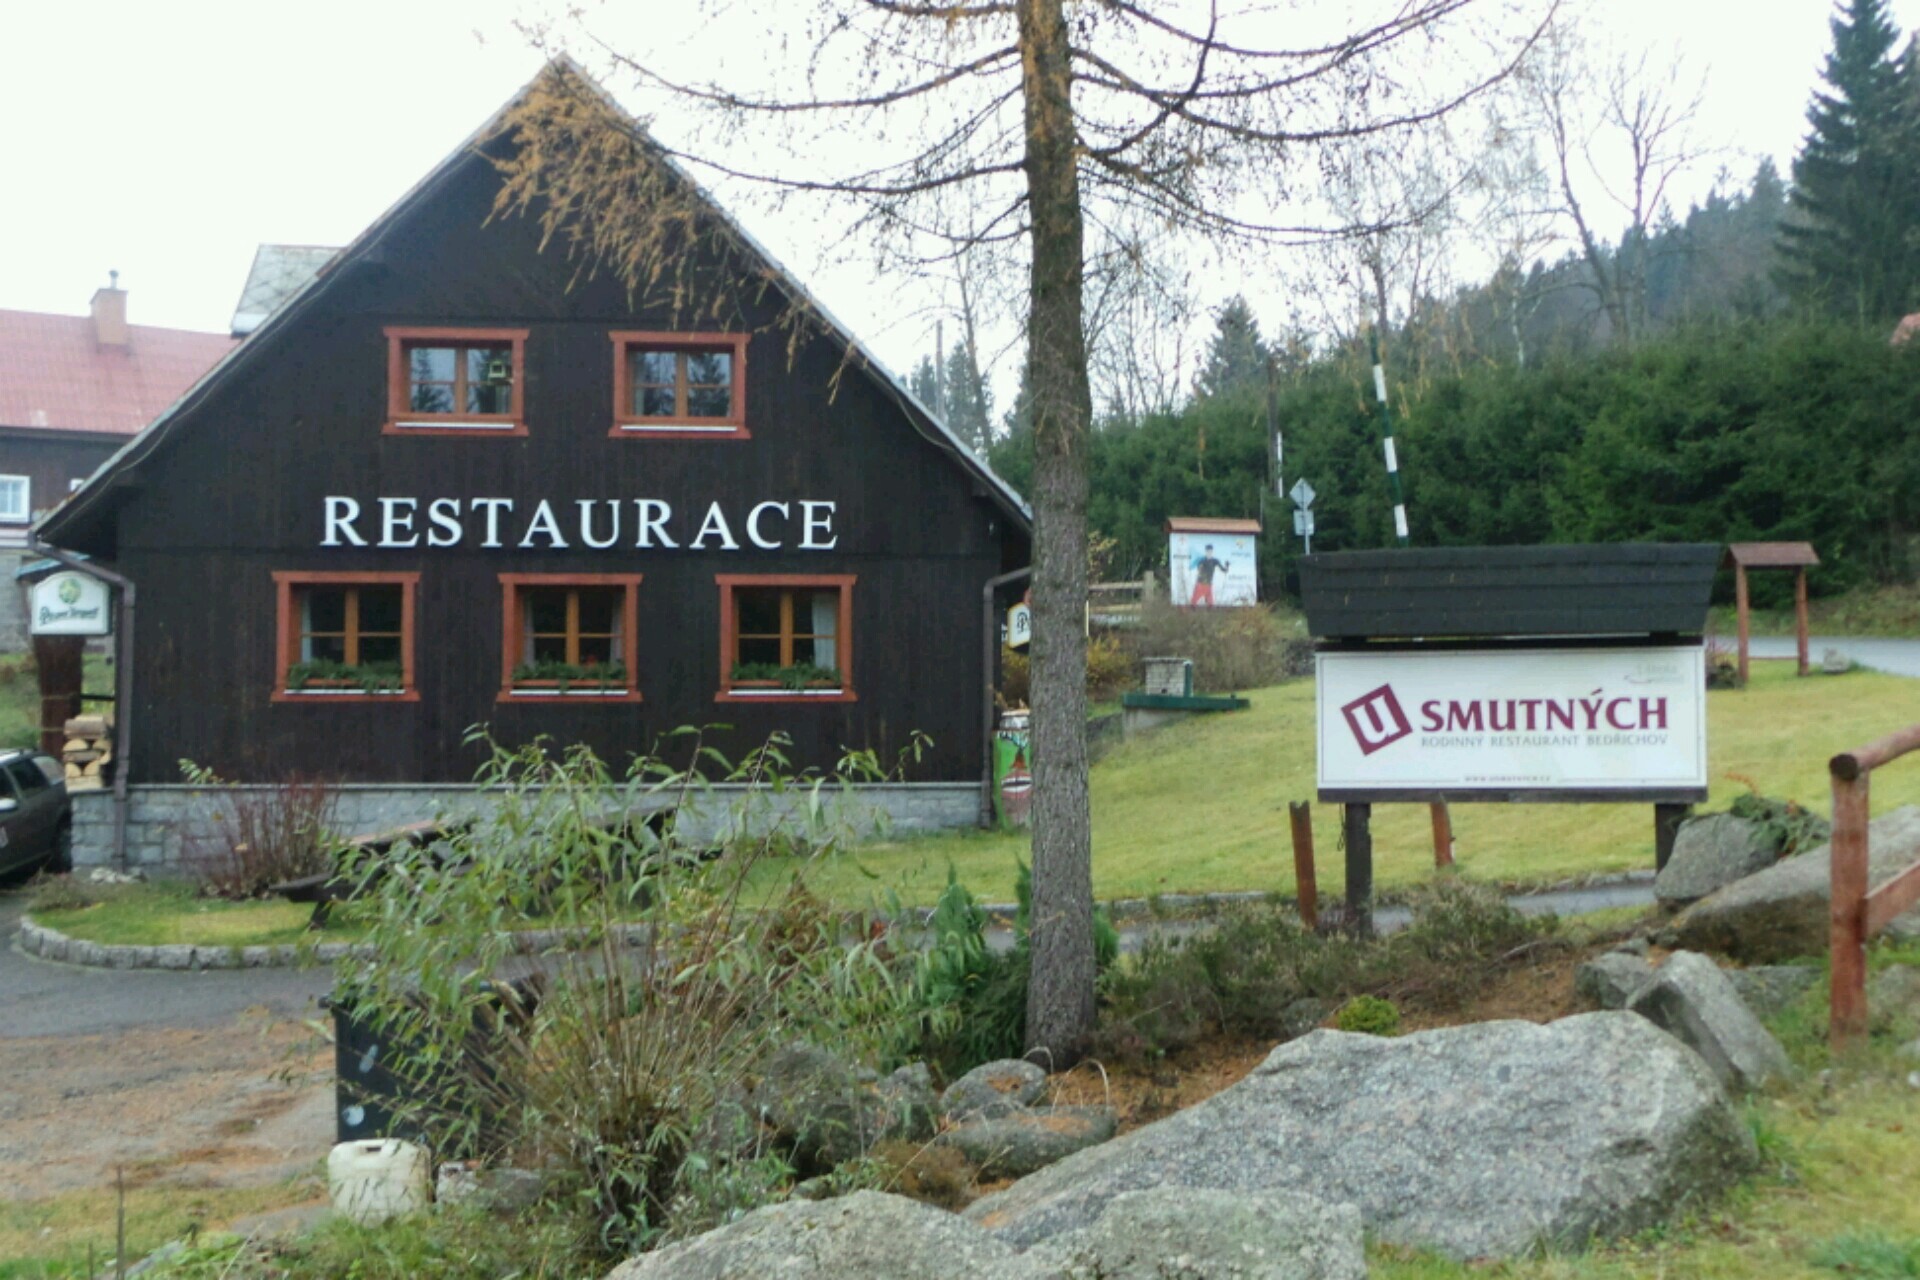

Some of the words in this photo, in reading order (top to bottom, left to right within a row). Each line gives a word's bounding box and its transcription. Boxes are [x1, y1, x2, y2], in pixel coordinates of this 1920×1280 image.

[319, 496, 838, 550] RESTAURACE
[1421, 688, 1668, 732] SMUTNÝCH
[1490, 734, 1579, 747] RESTAURANT
